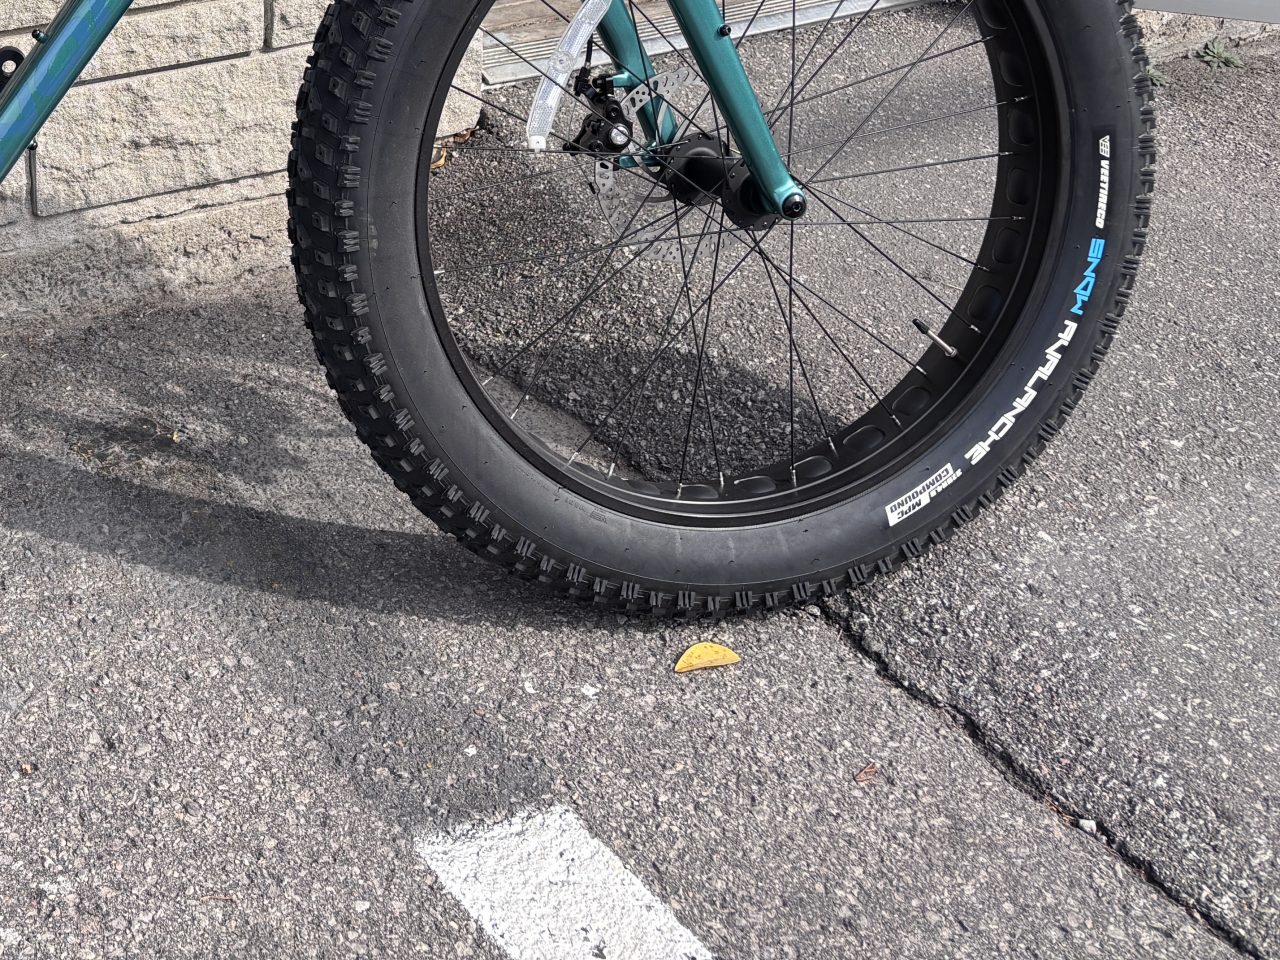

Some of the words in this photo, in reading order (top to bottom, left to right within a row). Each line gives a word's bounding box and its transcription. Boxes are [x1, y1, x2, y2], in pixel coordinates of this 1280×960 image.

[1070, 238, 1105, 316] SNOW
[964, 320, 1079, 466] AVALANCHE
[889, 465, 952, 514] COMPOUND
[896, 499, 924, 521] MPC
